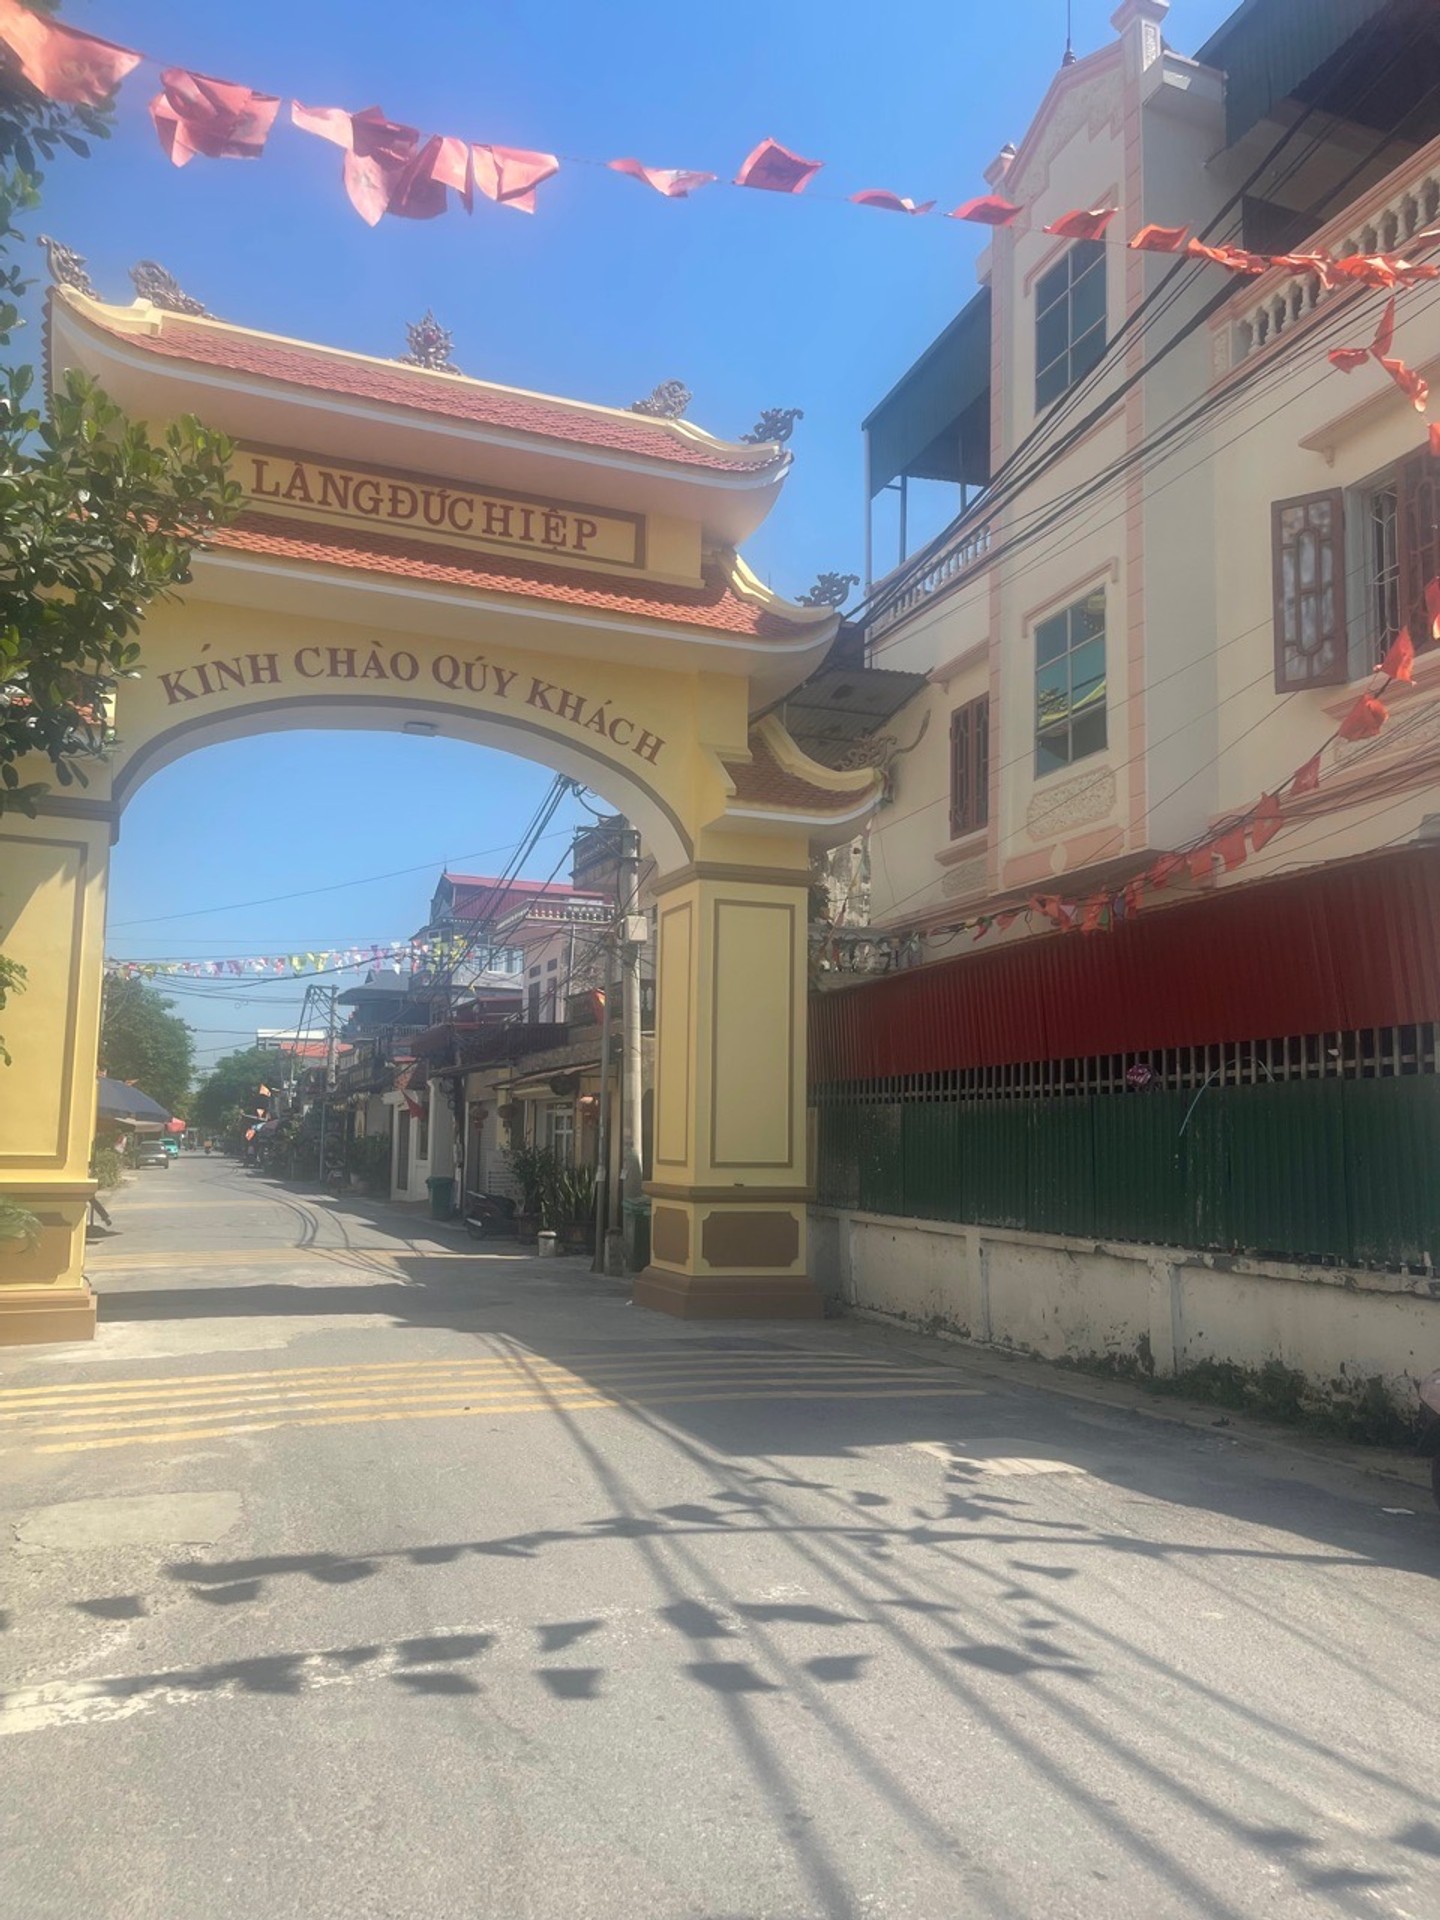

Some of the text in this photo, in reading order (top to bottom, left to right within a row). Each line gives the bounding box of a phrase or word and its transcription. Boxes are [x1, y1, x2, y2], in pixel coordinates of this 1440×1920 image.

[251, 459, 598, 551] LÀNG ĐỨC HIỆP
[157, 640, 666, 766] KÍNH CHÀO QÚY KHÁCH
